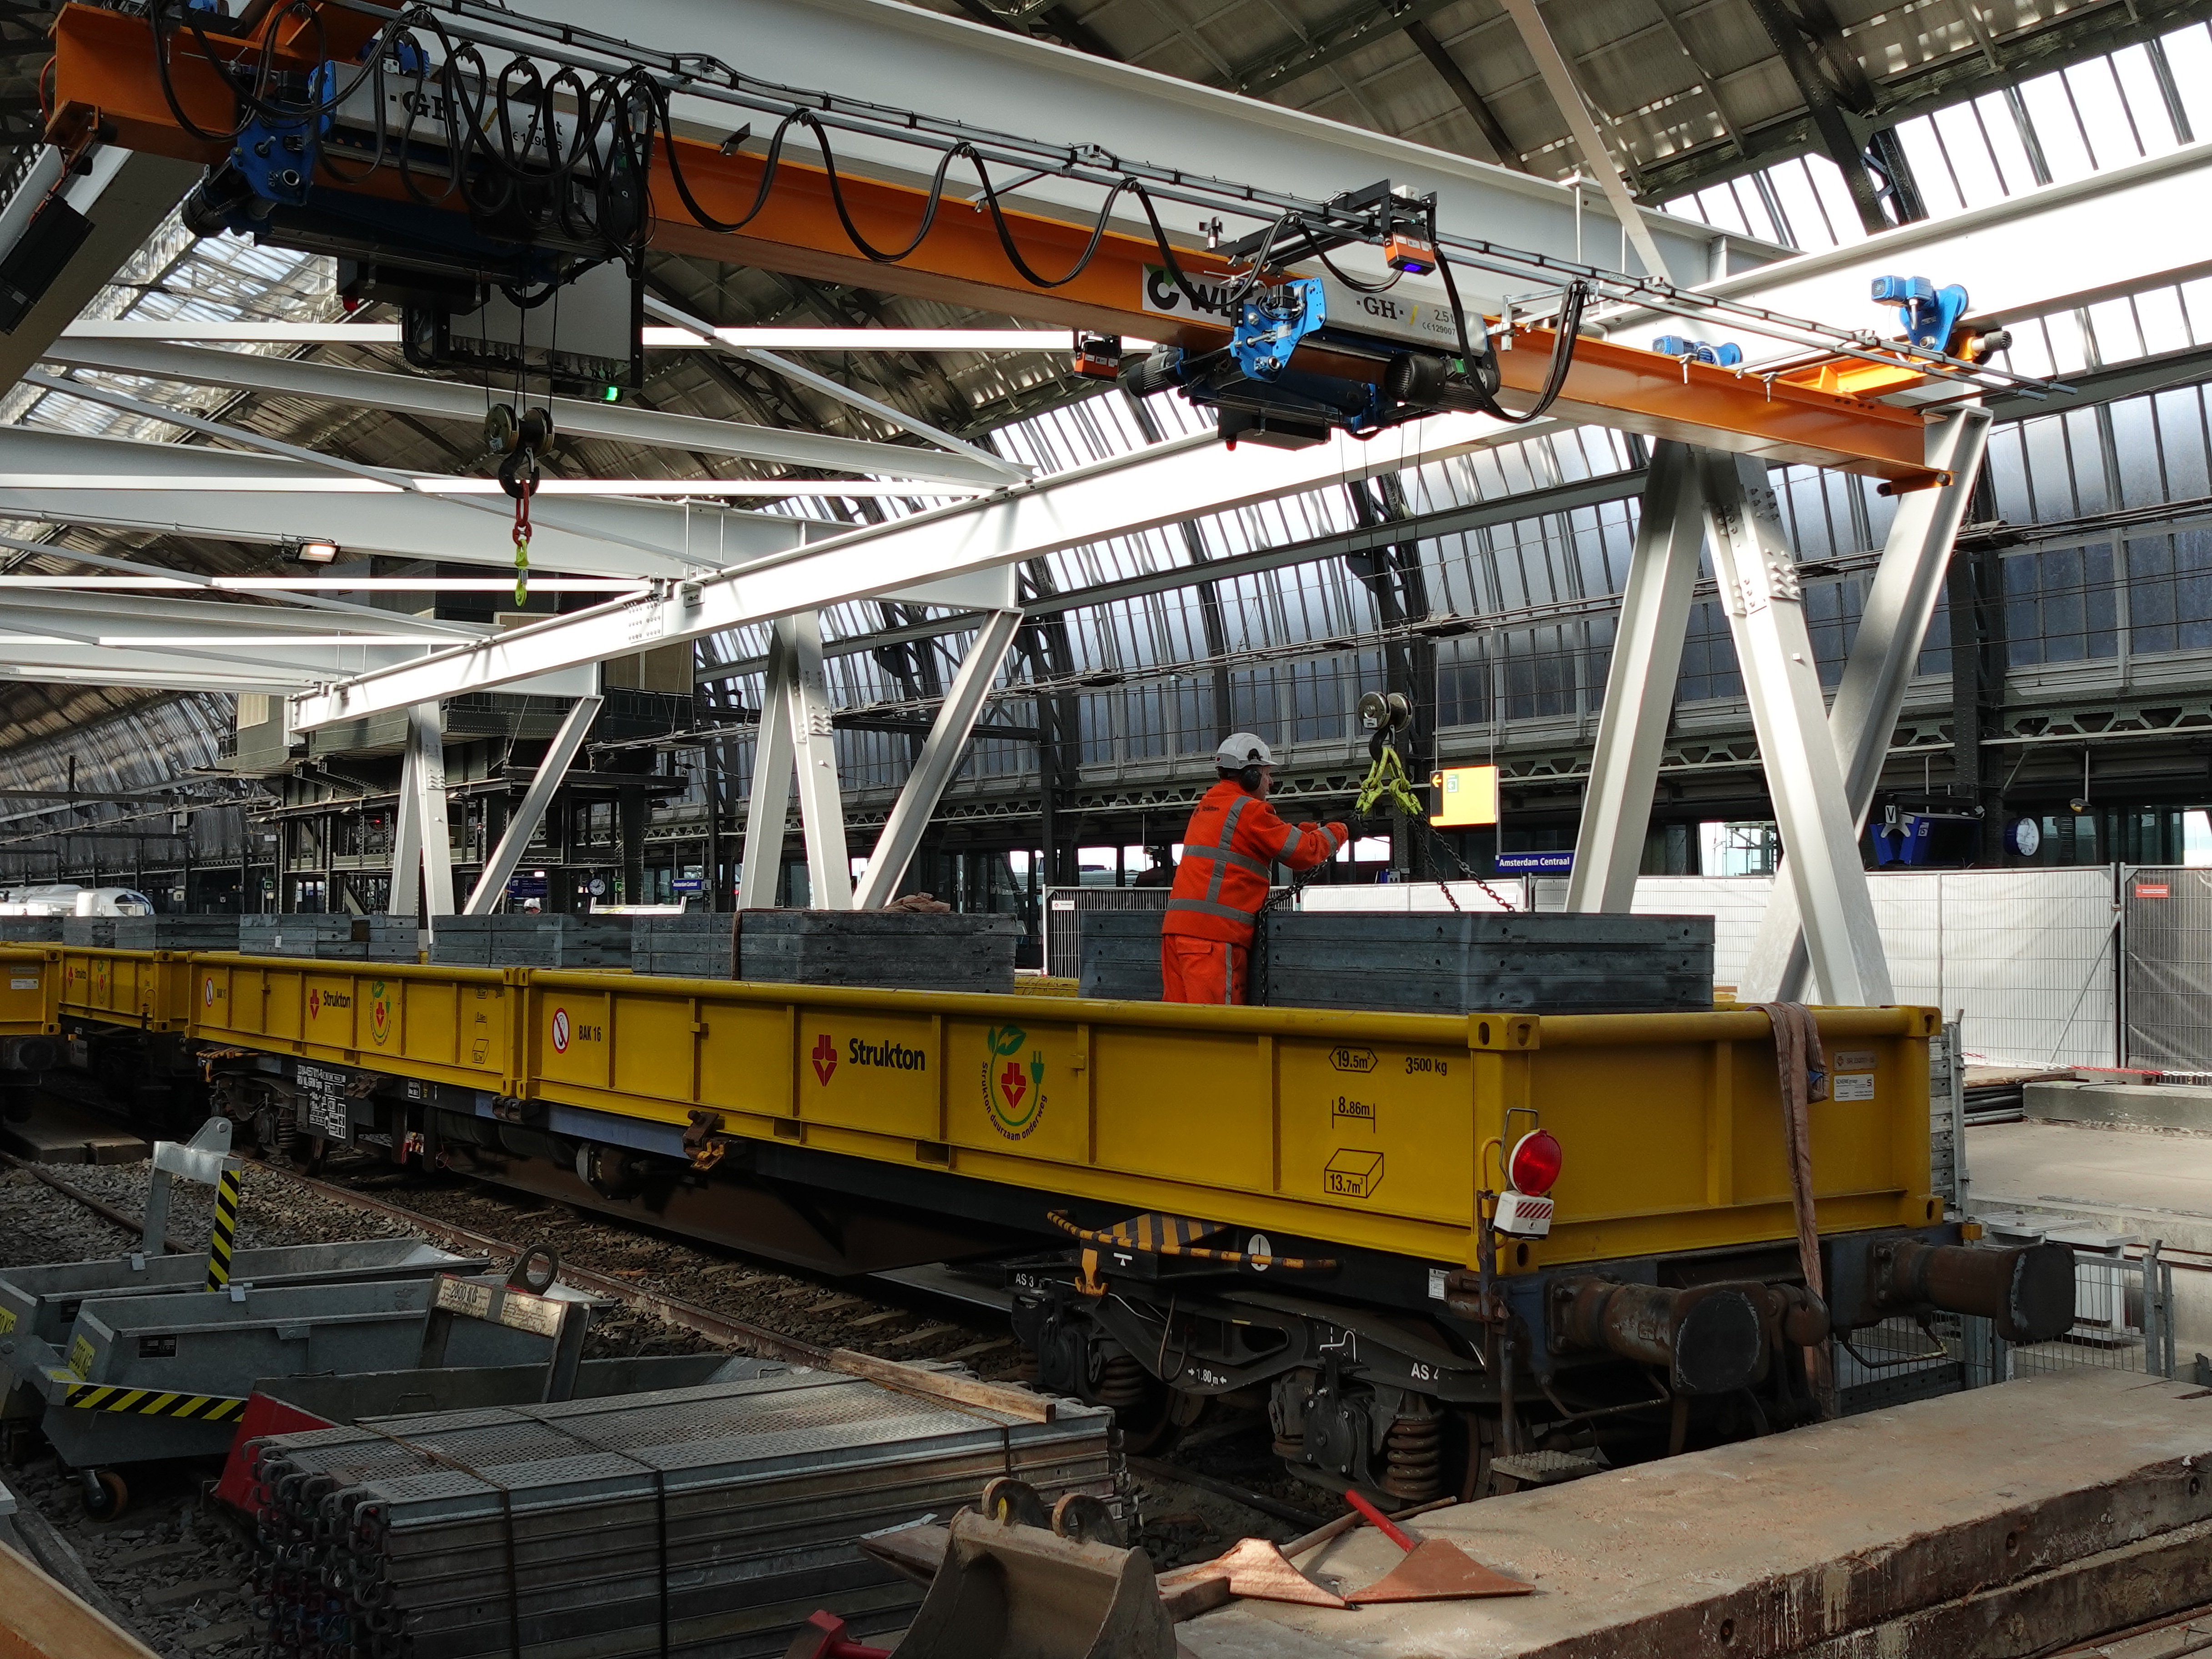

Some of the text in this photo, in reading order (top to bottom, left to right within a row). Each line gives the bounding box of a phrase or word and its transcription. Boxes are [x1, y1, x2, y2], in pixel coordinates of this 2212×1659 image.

[1499, 856, 1570, 867] Amsterdam Centraal
[323, 990, 351, 1008] Strukton
[579, 1025, 601, 1042] BAK 16
[849, 1037, 925, 1071] Strukton
[1405, 1056, 1447, 1076] 3500 kg
[981, 1061, 1048, 1141] Strukton duurzaam onderweg
[1338, 1096, 1370, 1116] 8.86m
[1015, 1273, 1034, 1287] AS 3
[1411, 1362, 1429, 1380] AS
